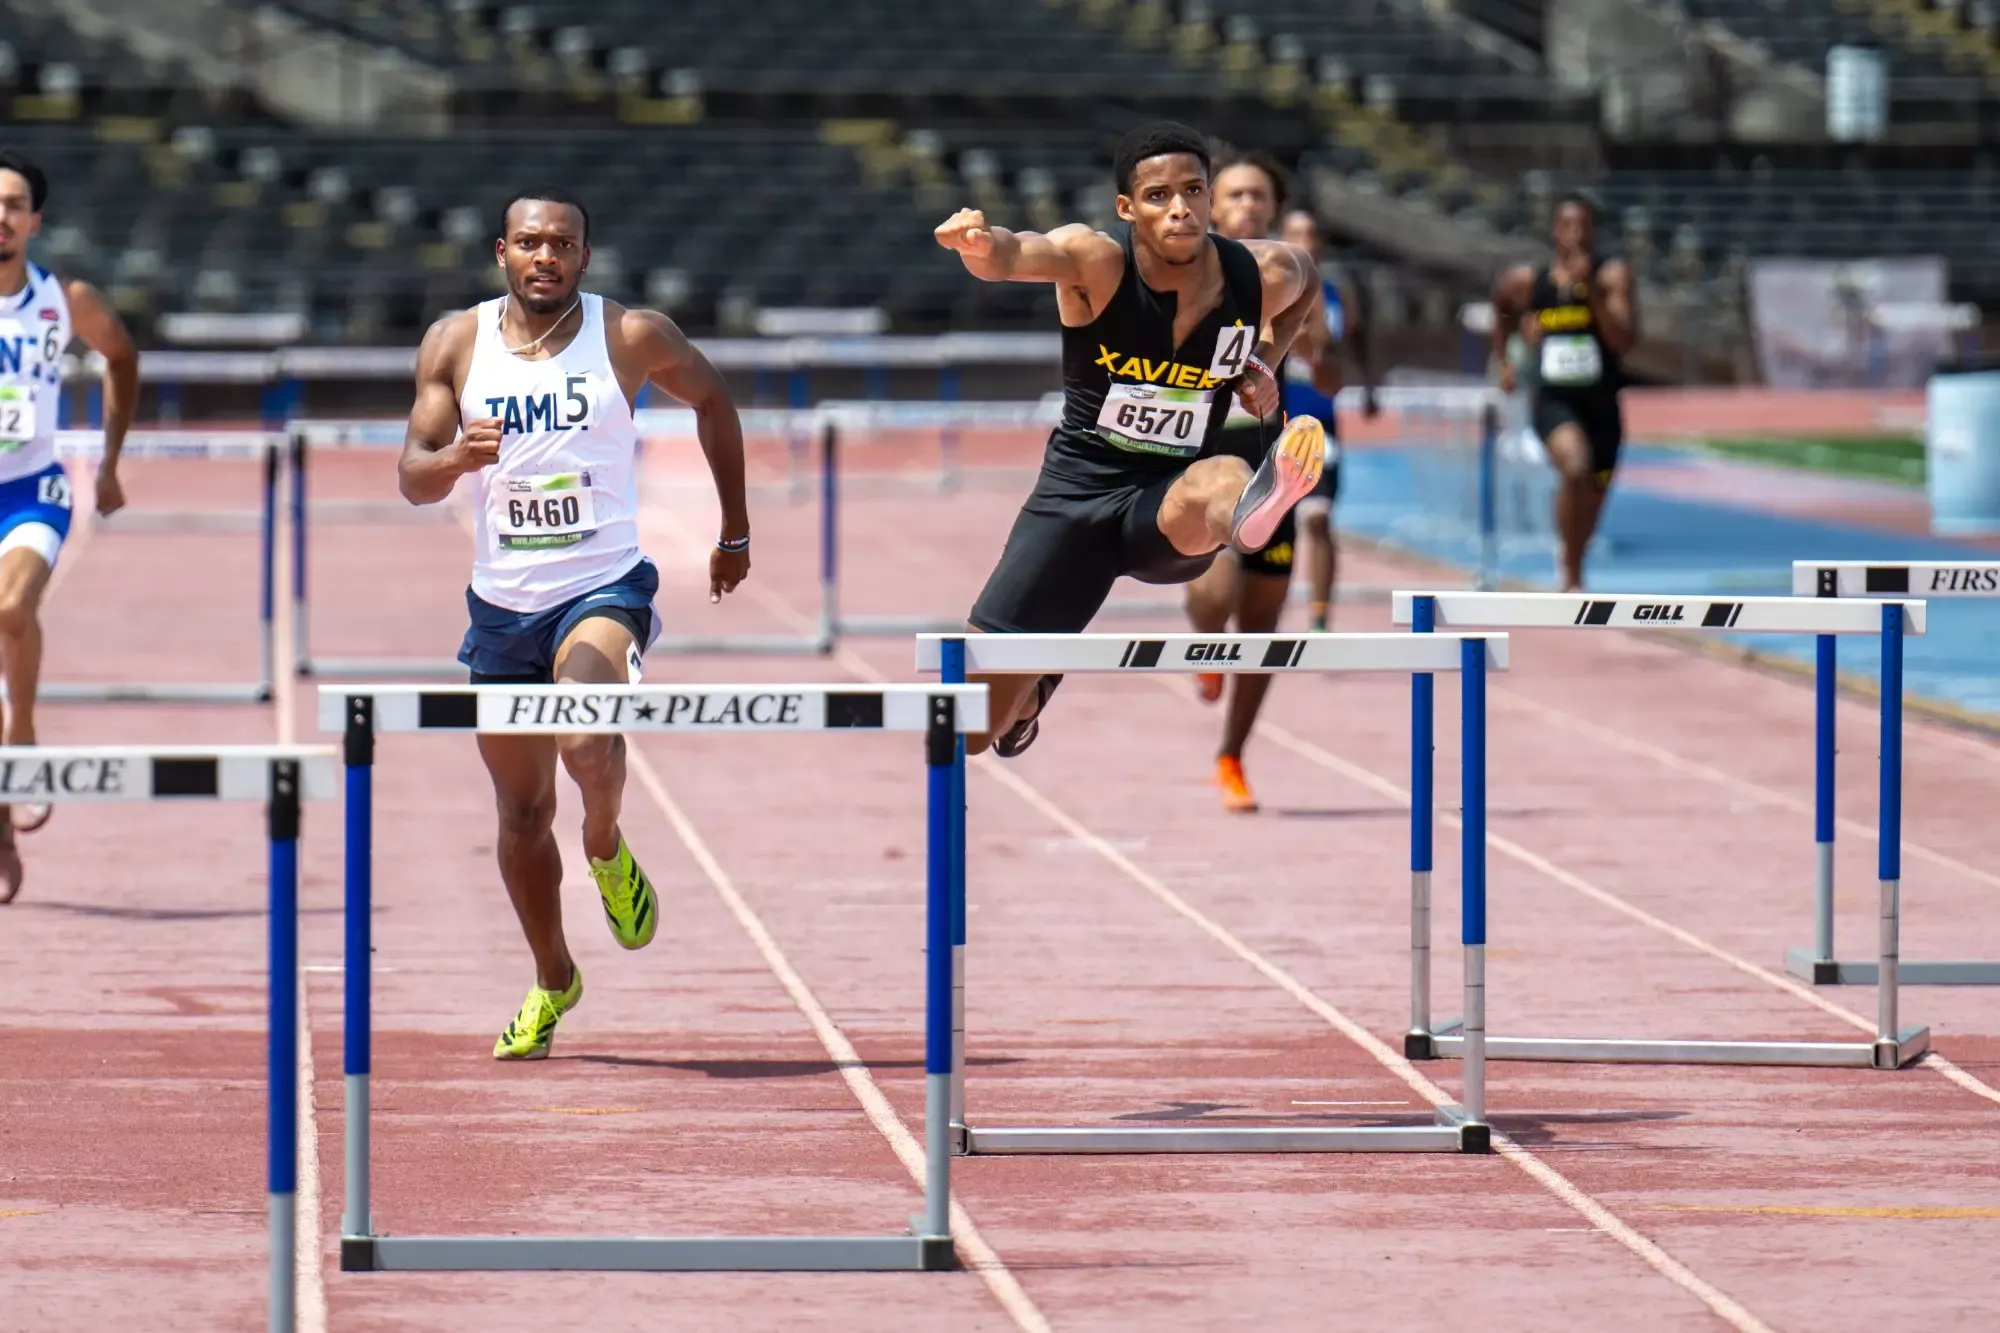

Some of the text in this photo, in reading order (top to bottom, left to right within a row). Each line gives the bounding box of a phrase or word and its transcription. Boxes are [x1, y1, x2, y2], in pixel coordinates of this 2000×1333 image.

[44, 323, 60, 362] 6
[1218, 329, 1246, 375] 4
[566, 376, 589, 423] 5
[1116, 403, 1195, 440] 6570
[508, 495, 580, 528] 6460
[1632, 604, 1684, 620] GILL
[1184, 643, 1242, 661] GILL
[506, 694, 804, 725] FIRST PLACE
